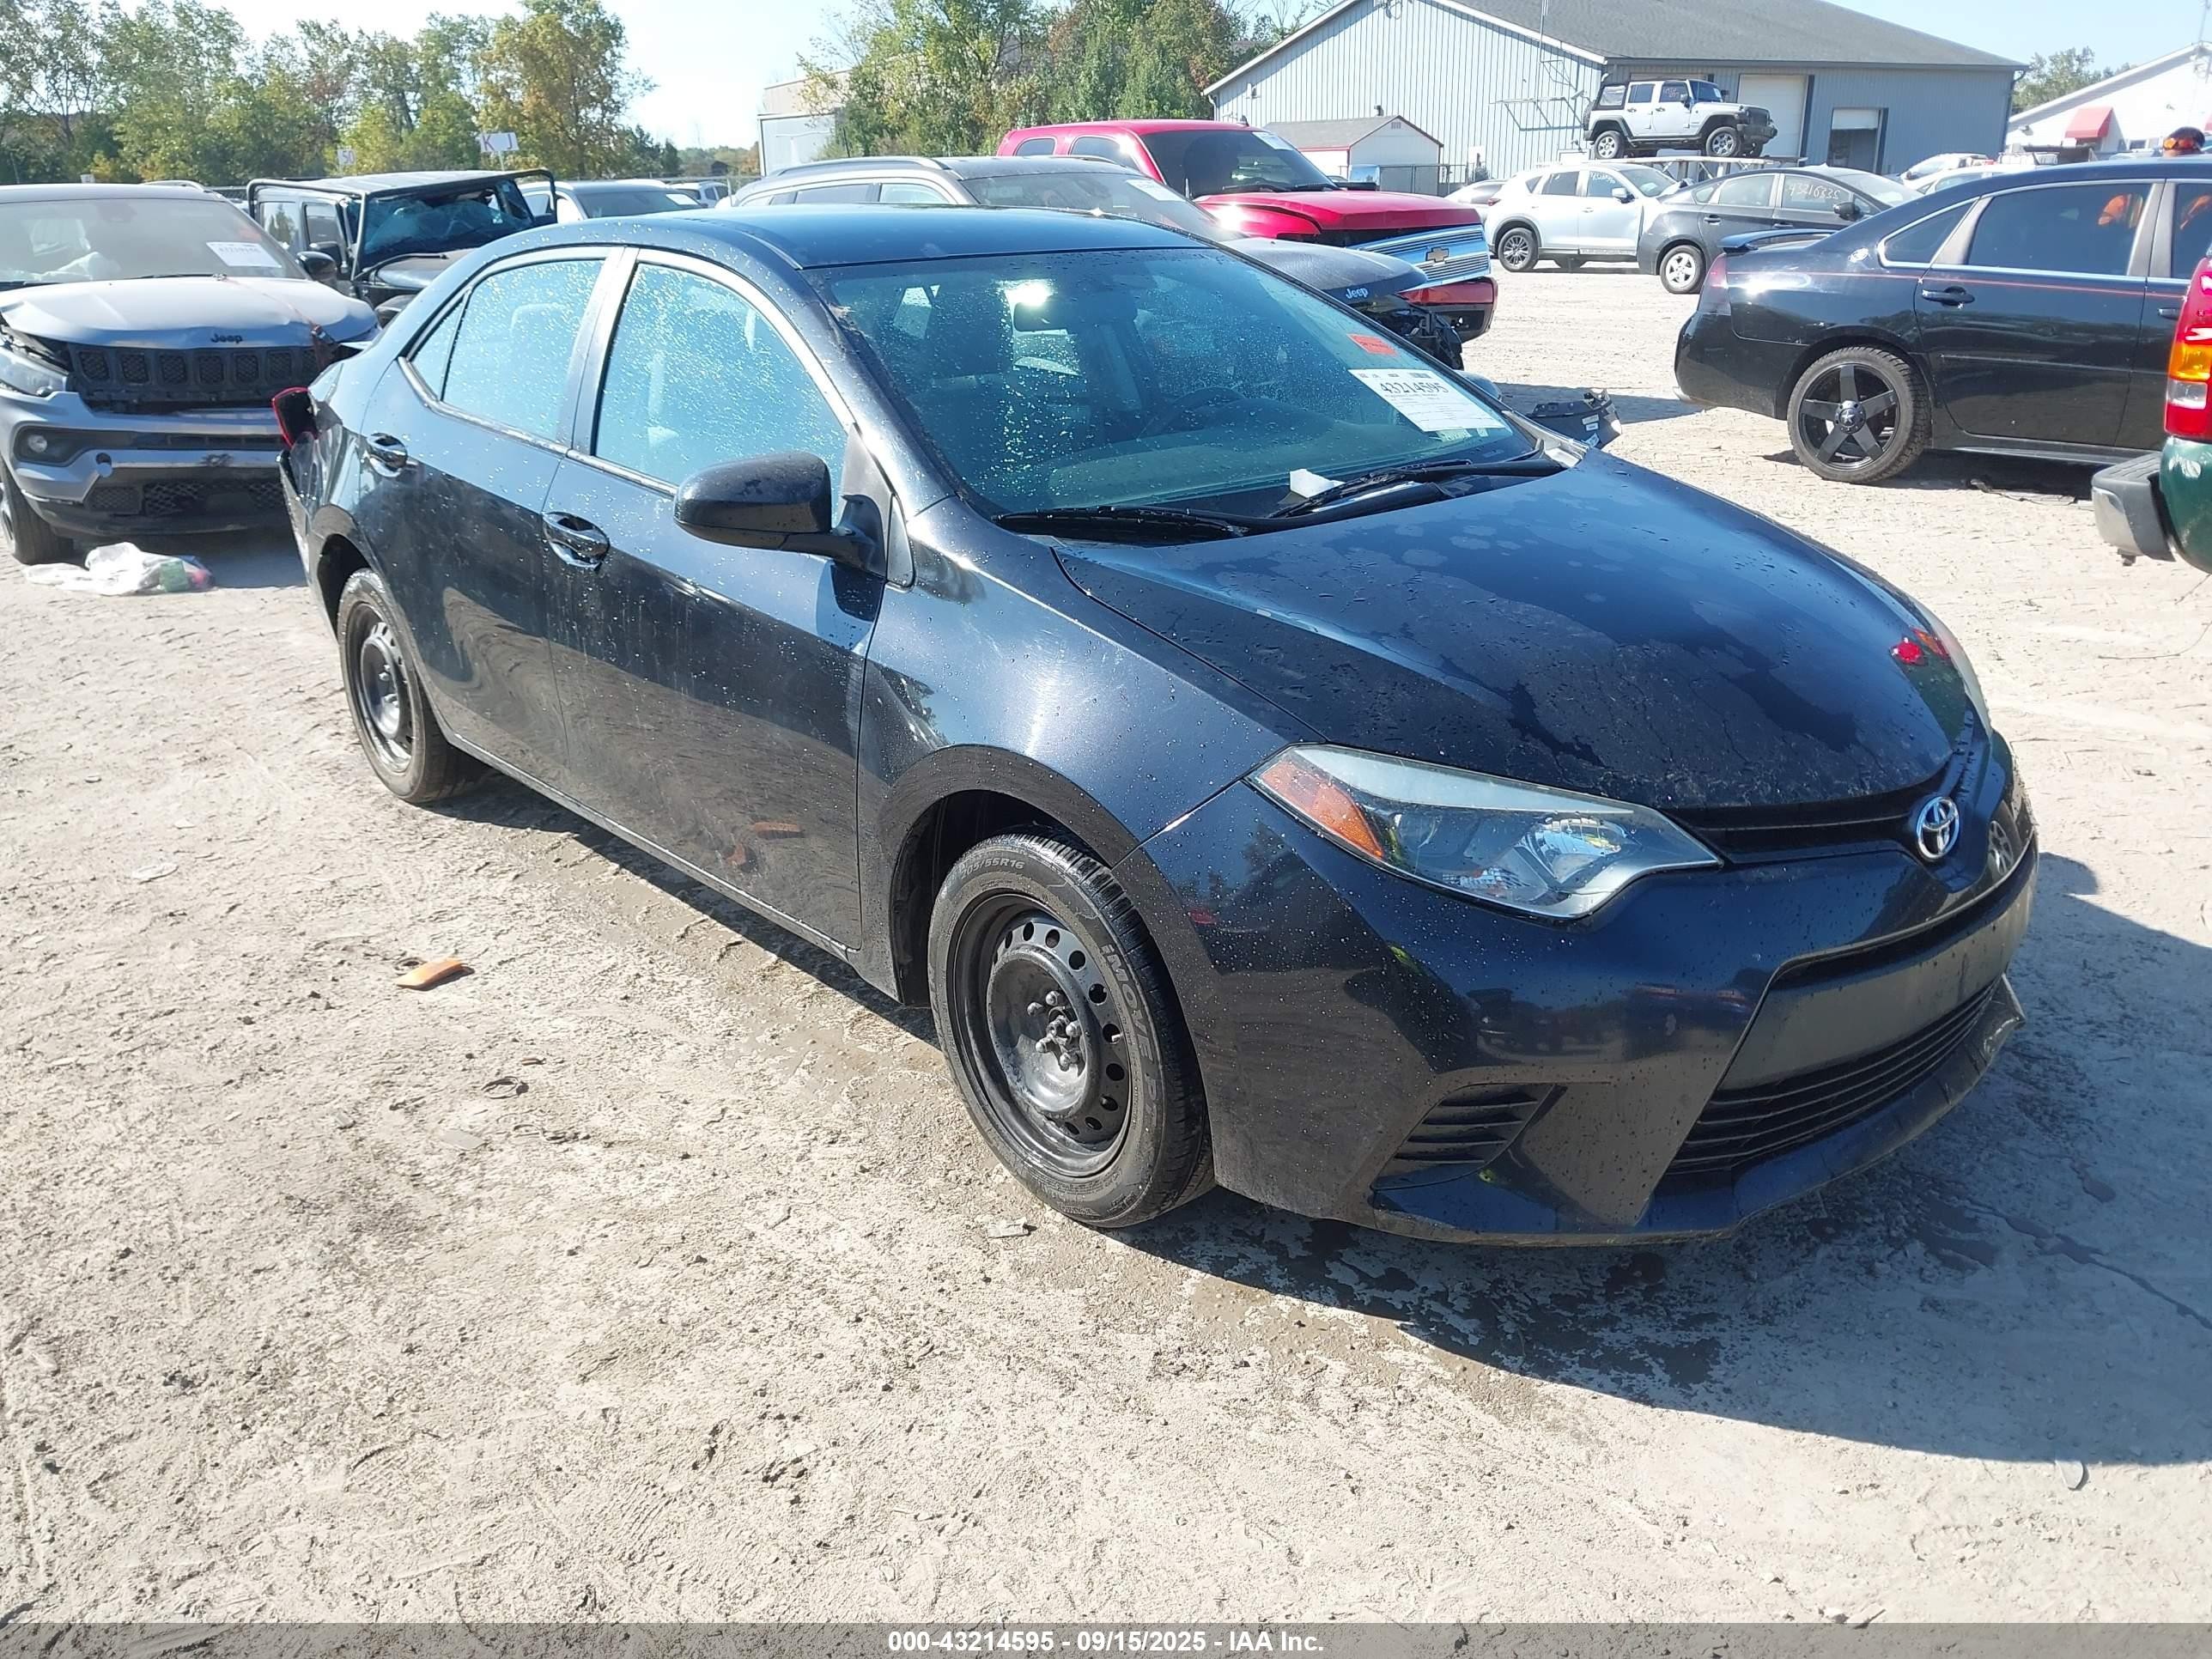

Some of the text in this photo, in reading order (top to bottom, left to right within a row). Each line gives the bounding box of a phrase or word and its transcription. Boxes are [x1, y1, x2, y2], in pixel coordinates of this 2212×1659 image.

[483, 133, 514, 151] K J
[1346, 288, 1369, 299] Jeep
[210, 332, 243, 344] Jeep
[1380, 382, 1449, 393] 43214595
[961, 857, 1025, 880] 205/55R16
